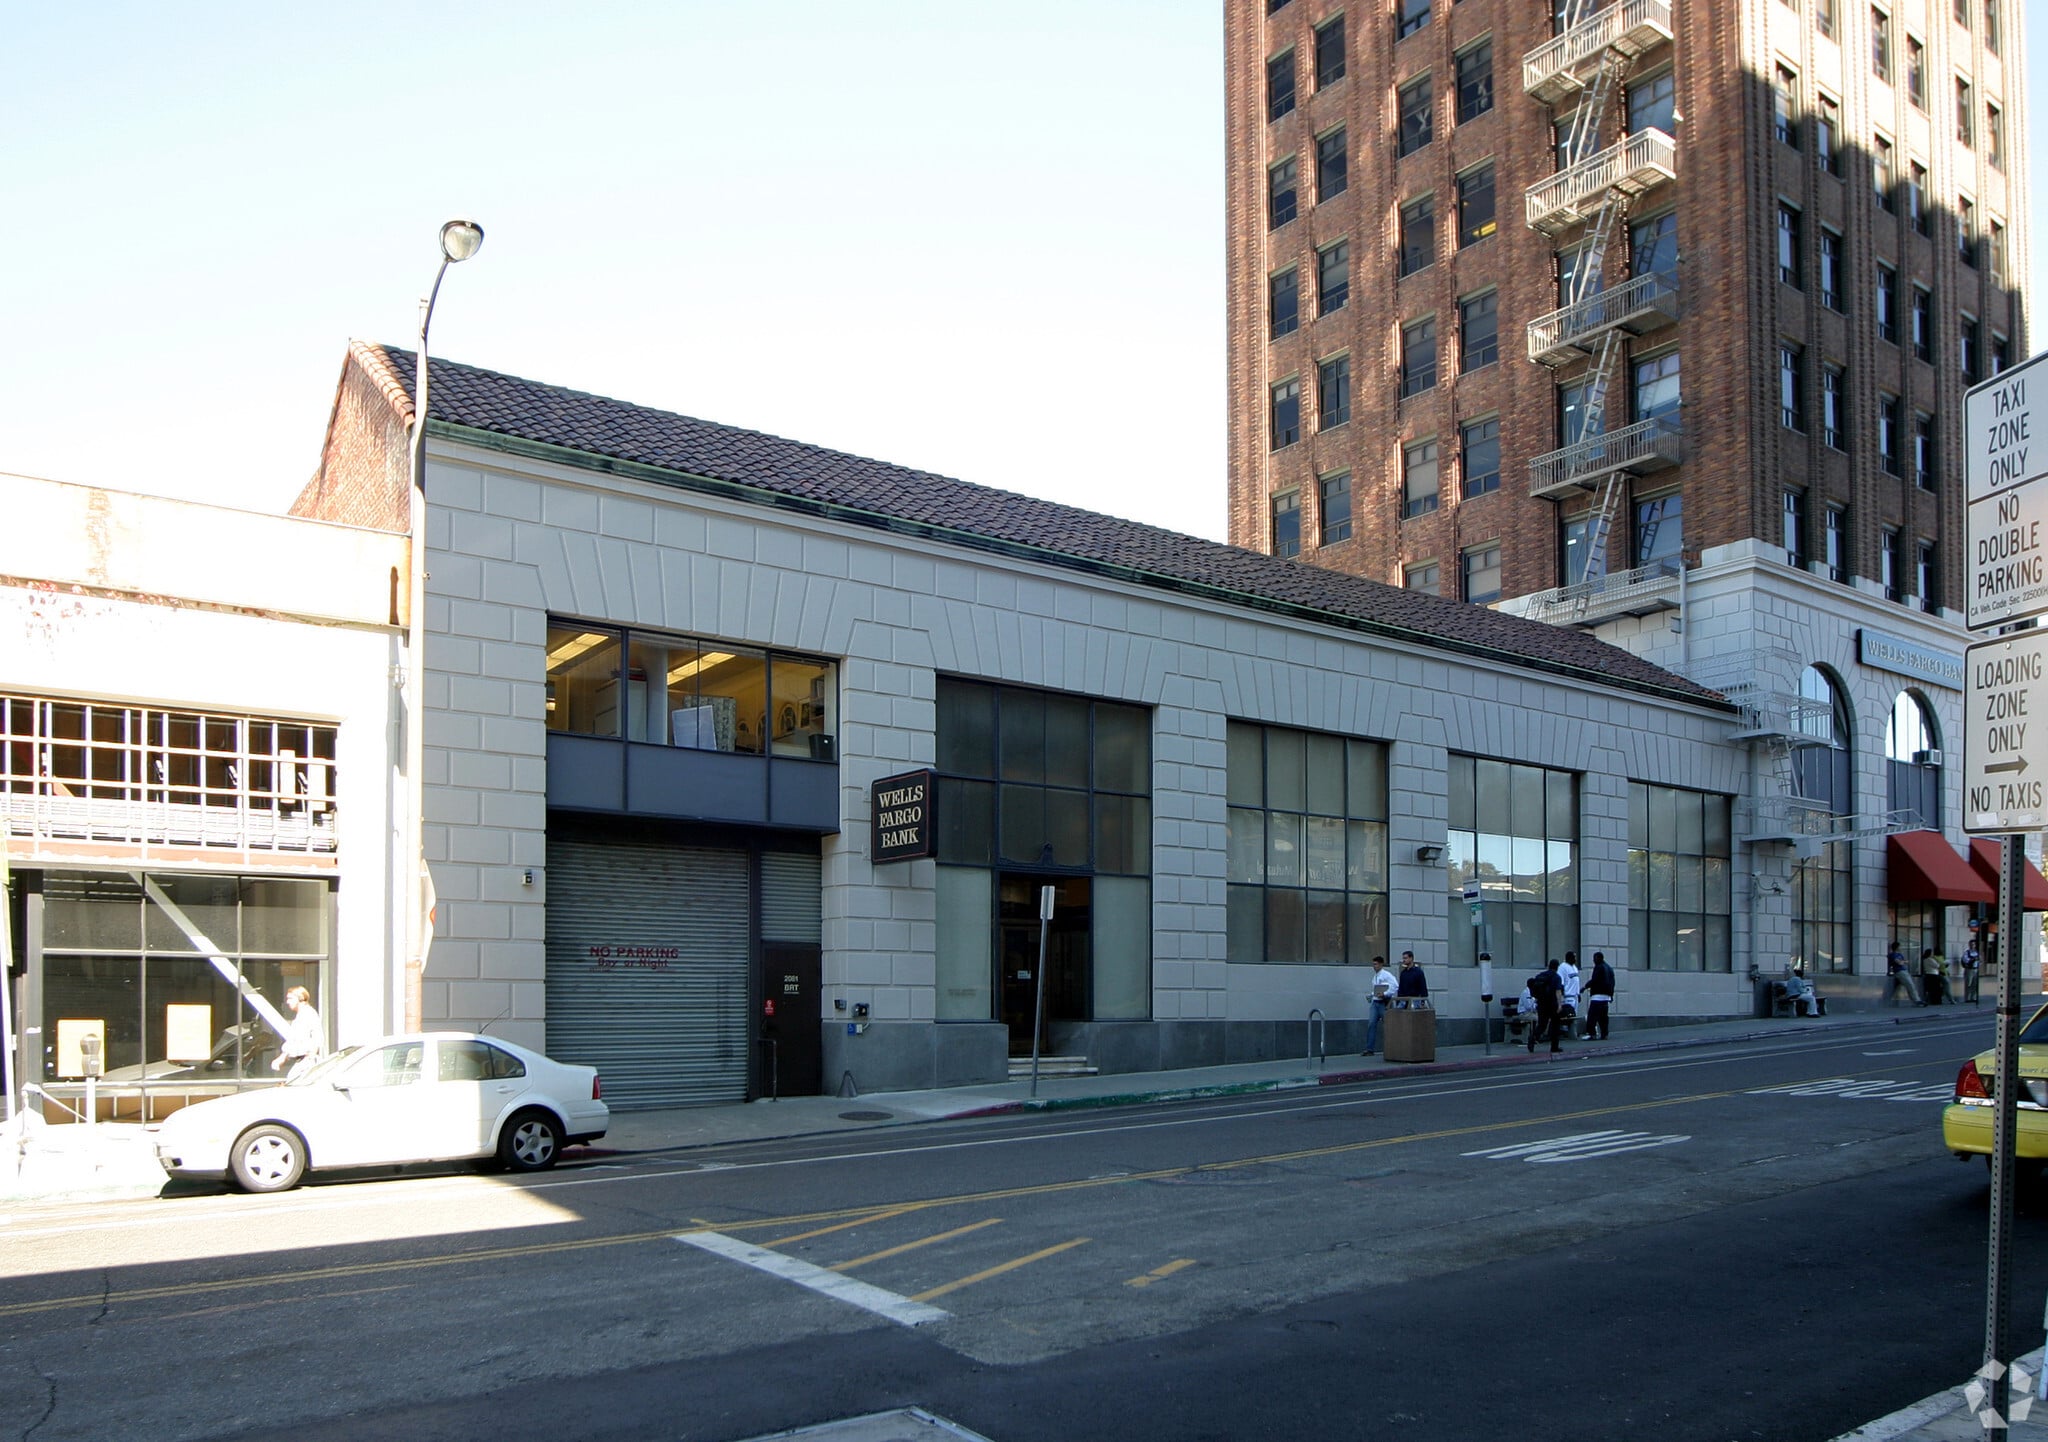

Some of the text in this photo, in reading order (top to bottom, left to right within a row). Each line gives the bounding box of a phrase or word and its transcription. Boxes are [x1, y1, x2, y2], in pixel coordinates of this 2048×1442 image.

[1993, 379, 2025, 418] TAXI
[1988, 412, 2030, 455] ZONE
[1989, 447, 2028, 487] ONLY
[1998, 494, 2019, 527] NO
[1979, 520, 2040, 566] DOUBLE
[1978, 556, 2042, 599] PARKING
[1992, 600, 2006, 610] Code
[1867, 639, 1906, 664] WELLS
[1908, 652, 1940, 674] FARGO
[1976, 652, 2041, 690] LOADING
[1986, 689, 2028, 720] ZONE
[1988, 722, 2027, 753] ONLY
[878, 785, 924, 808] WELLS
[1971, 781, 2042, 812] NO TAXIS
[878, 806, 921, 829] FARGO
[881, 827, 919, 848] BANK
[590, 946, 679, 958] NO PARKING
[598, 958, 617, 967] Day
[639, 958, 669, 970] Night
[1459, 1129, 1692, 1163] NO
